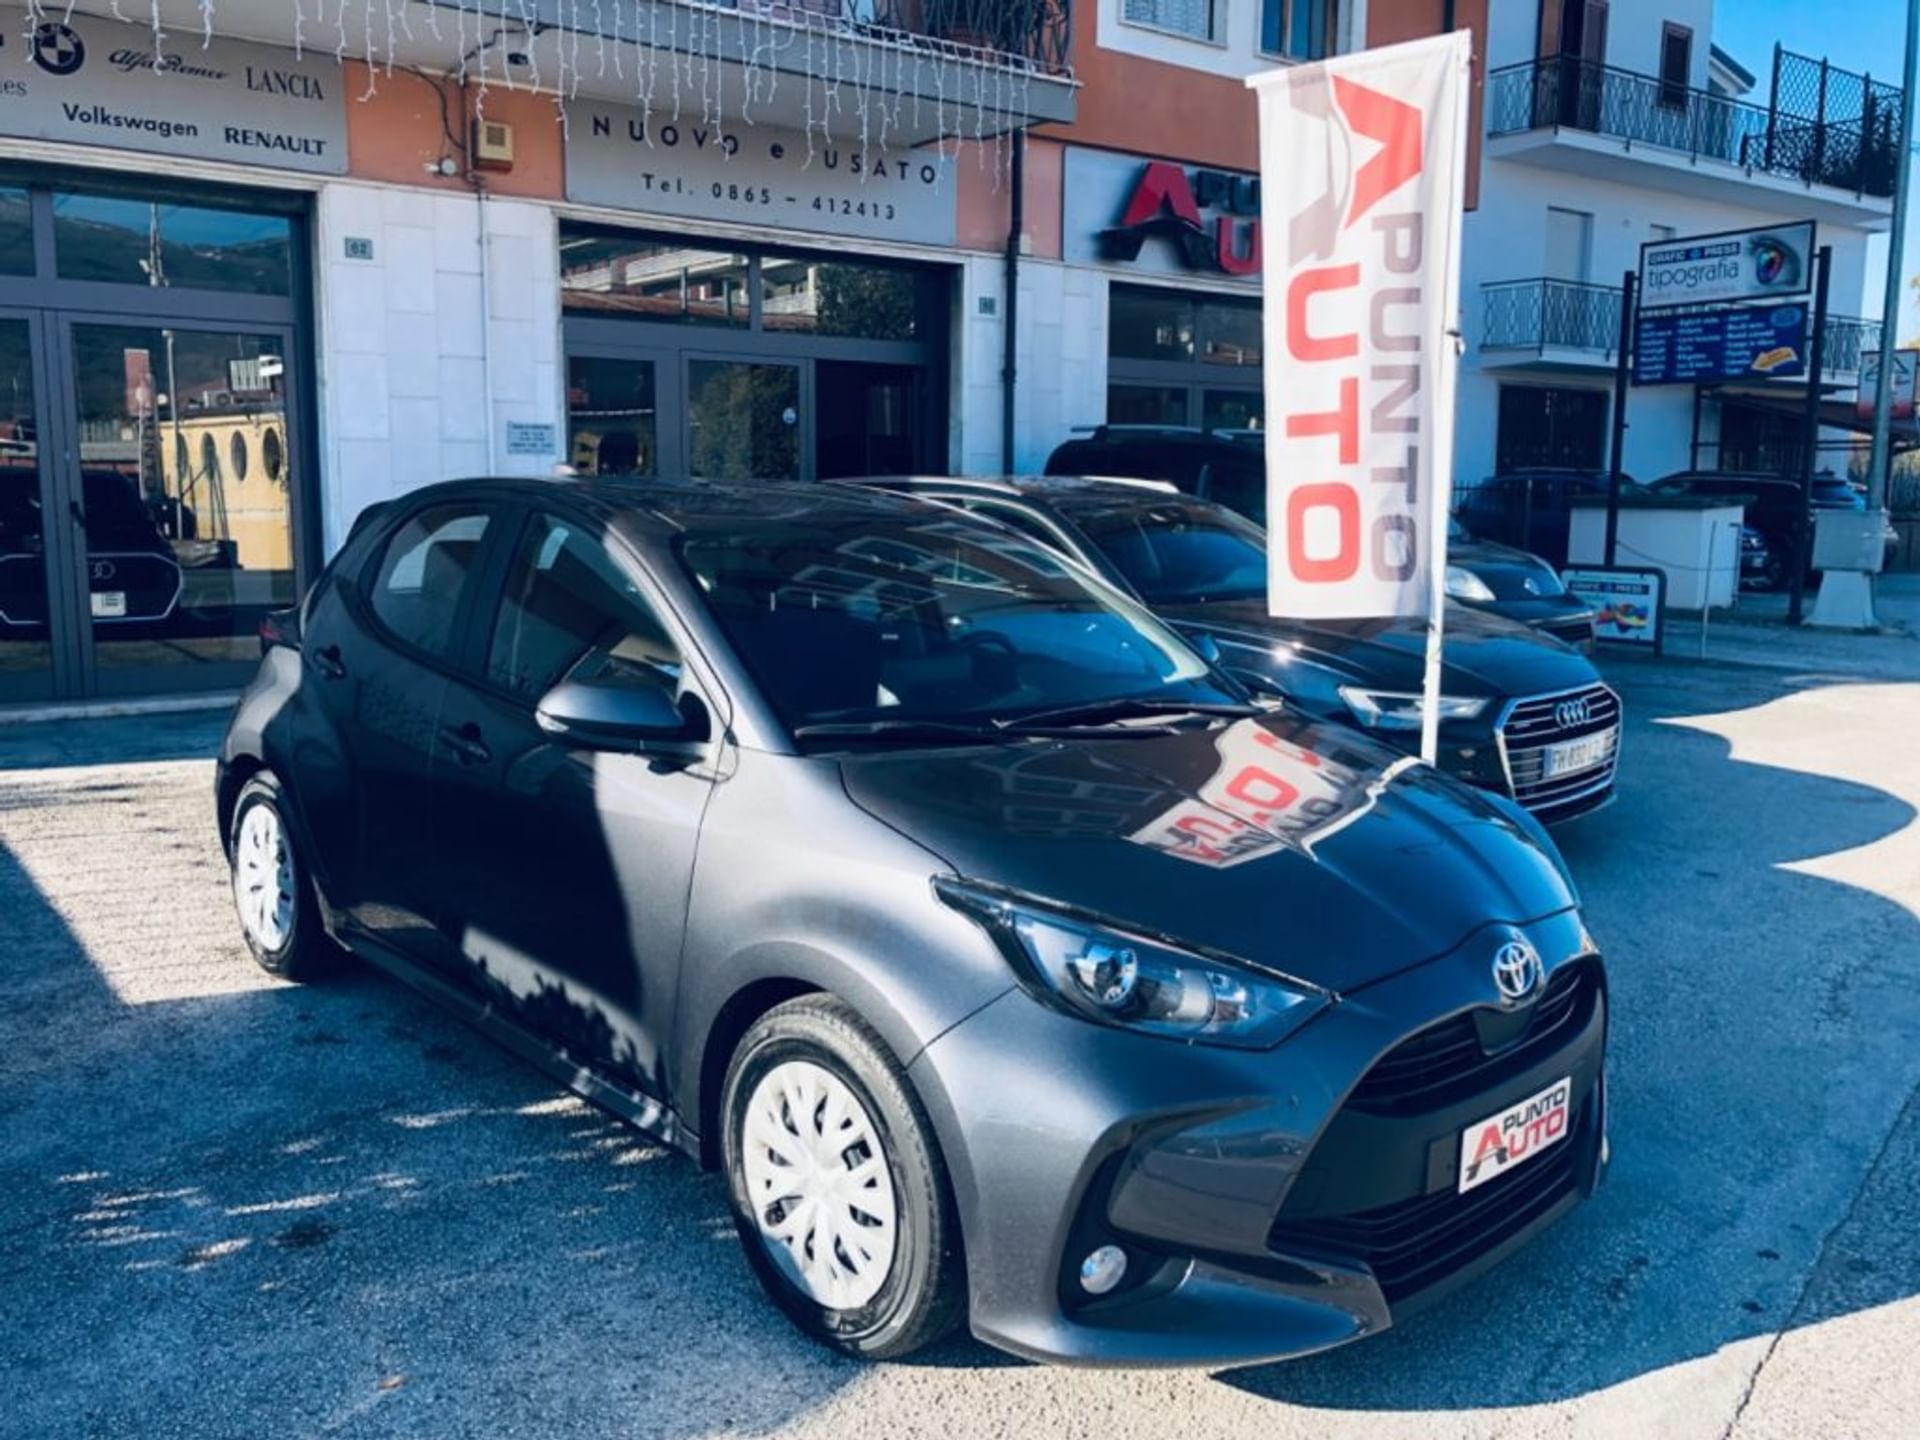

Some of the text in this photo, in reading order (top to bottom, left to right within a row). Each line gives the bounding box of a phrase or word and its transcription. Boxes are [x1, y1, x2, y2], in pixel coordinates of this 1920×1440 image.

[245, 66, 324, 101] LANCIA
[62, 102, 199, 138] Volkswagen
[224, 126, 327, 156] RENAULT
[592, 115, 936, 184] NUOVO e USATO
[642, 173, 694, 196] Tel.
[712, 182, 771, 204] 0865
[812, 196, 895, 220] 412413
[1648, 257, 1740, 291] tipografia
[1287, 64, 1423, 584] AUTO
[1370, 212, 1423, 583] PUNTO
[1503, 1087, 1566, 1135] PUNTO
[1465, 1106, 1566, 1183] AUTO
